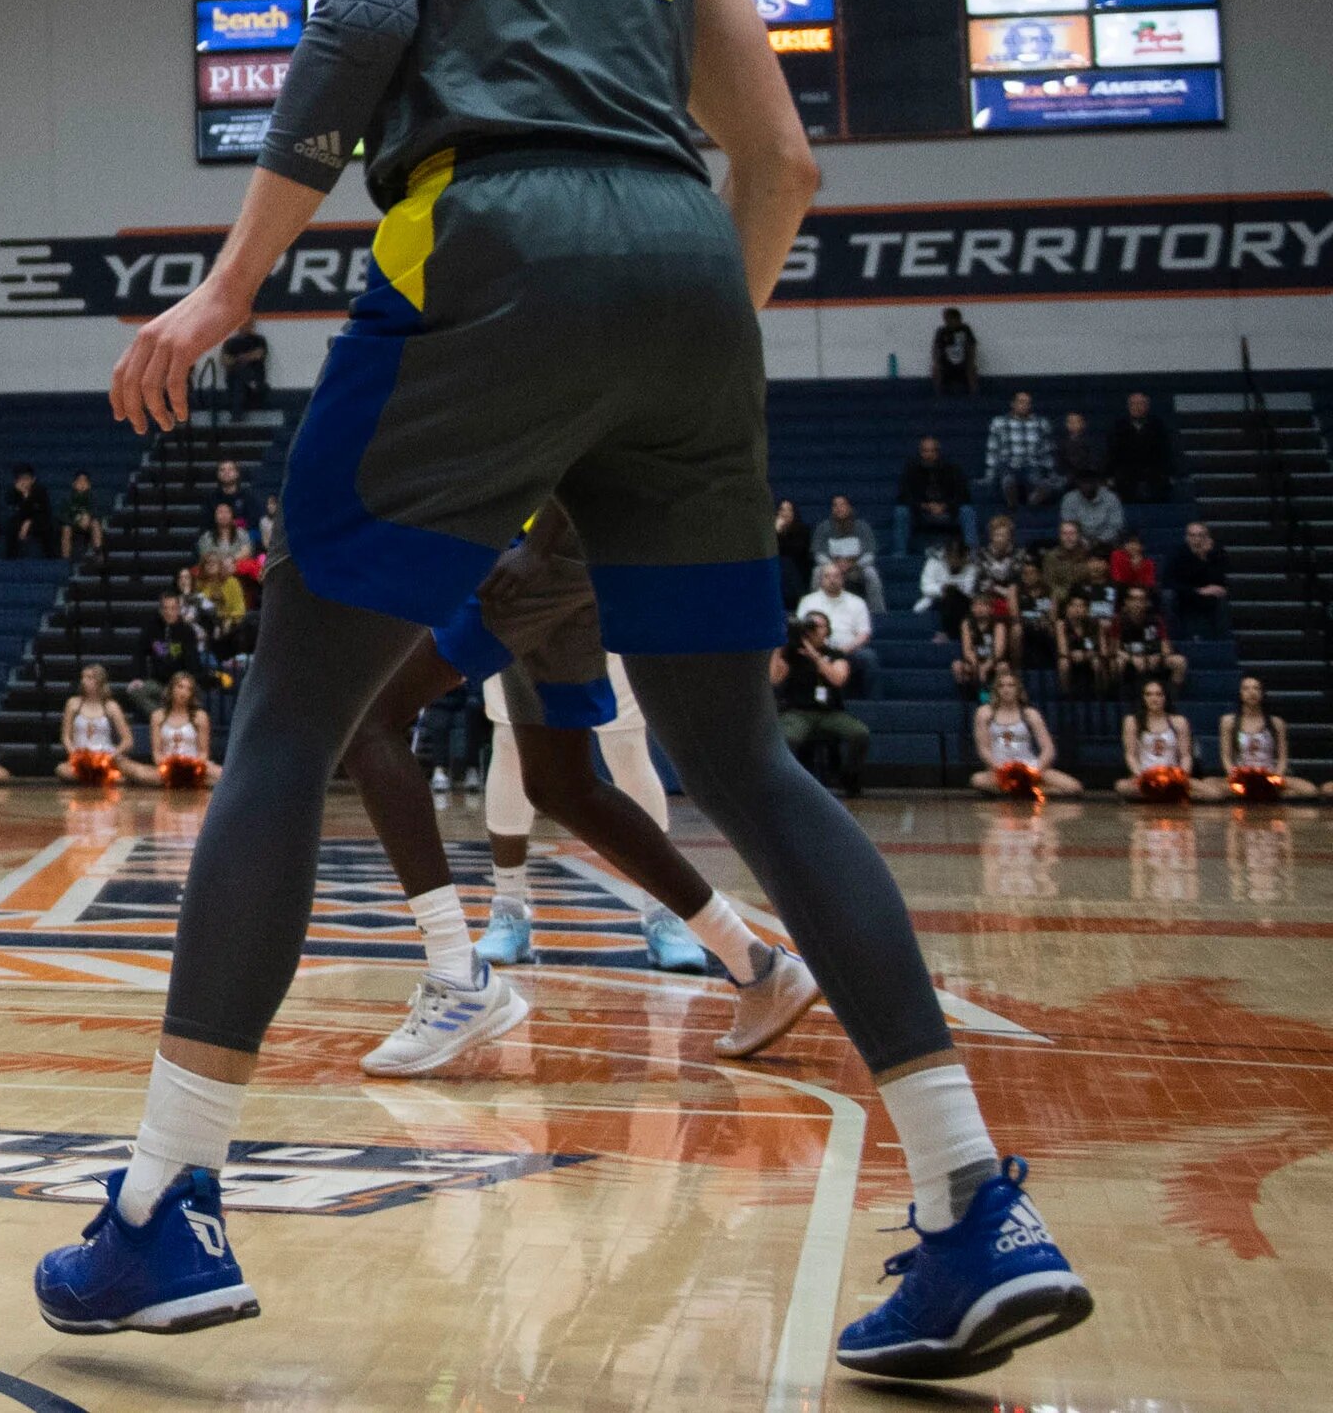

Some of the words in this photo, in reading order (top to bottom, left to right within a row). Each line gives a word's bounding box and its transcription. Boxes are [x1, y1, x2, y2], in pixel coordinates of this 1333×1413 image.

[212, 4, 289, 31] bench
[1090, 79, 1189, 96] AMERICA
[849, 221, 1333, 279] TERRITORY
[996, 1225, 1054, 1253] adid
